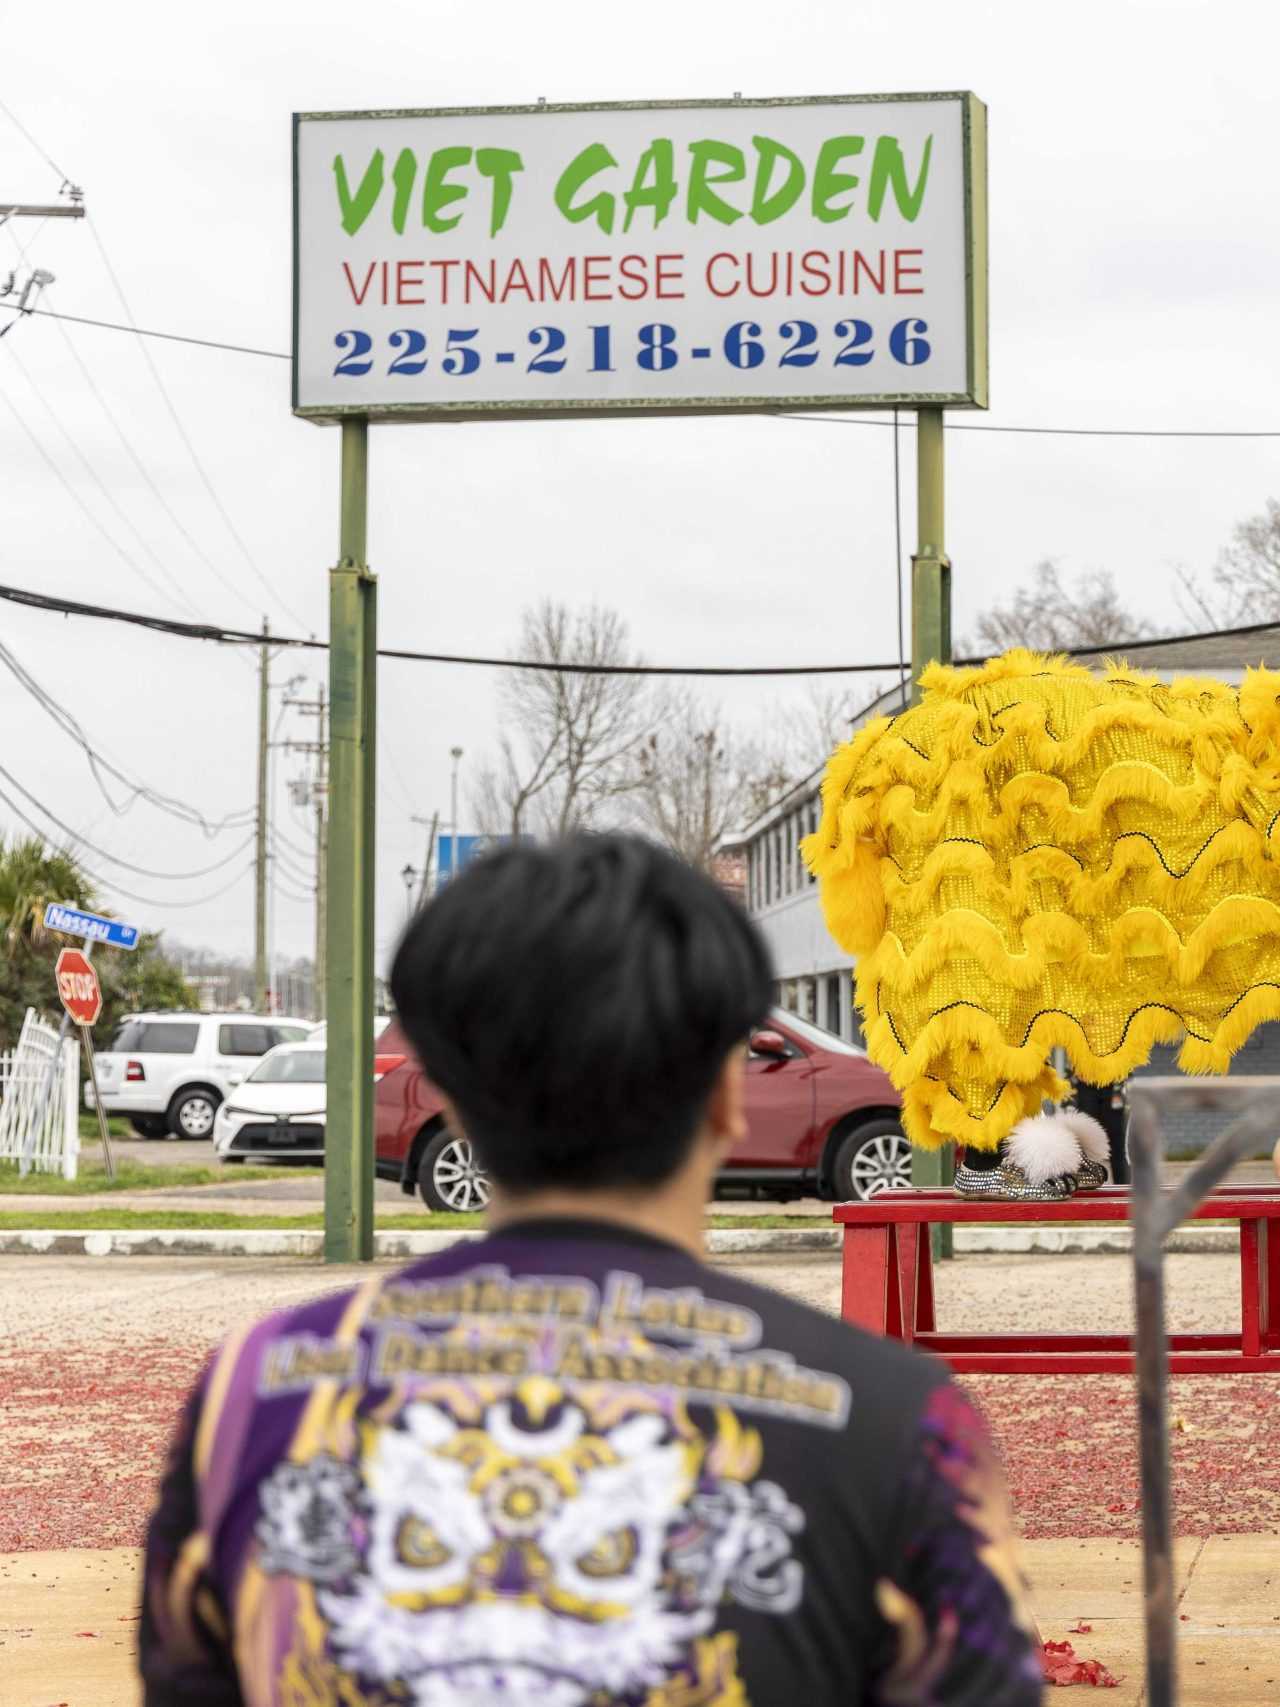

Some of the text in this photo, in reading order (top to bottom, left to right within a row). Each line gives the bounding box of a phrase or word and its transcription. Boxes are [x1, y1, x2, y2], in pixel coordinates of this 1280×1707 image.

[333, 135, 932, 237] VIET GARDEN
[342, 248, 924, 305] VIETNAMESE CUISINE
[333, 317, 931, 377] 225-218-6226
[48, 908, 110, 940] Nassau
[60, 971, 97, 1001] STOP
[368, 1270, 754, 1340] Southern Lotus
[374, 1325, 531, 1382] Dance
[556, 1331, 845, 1418] Association
